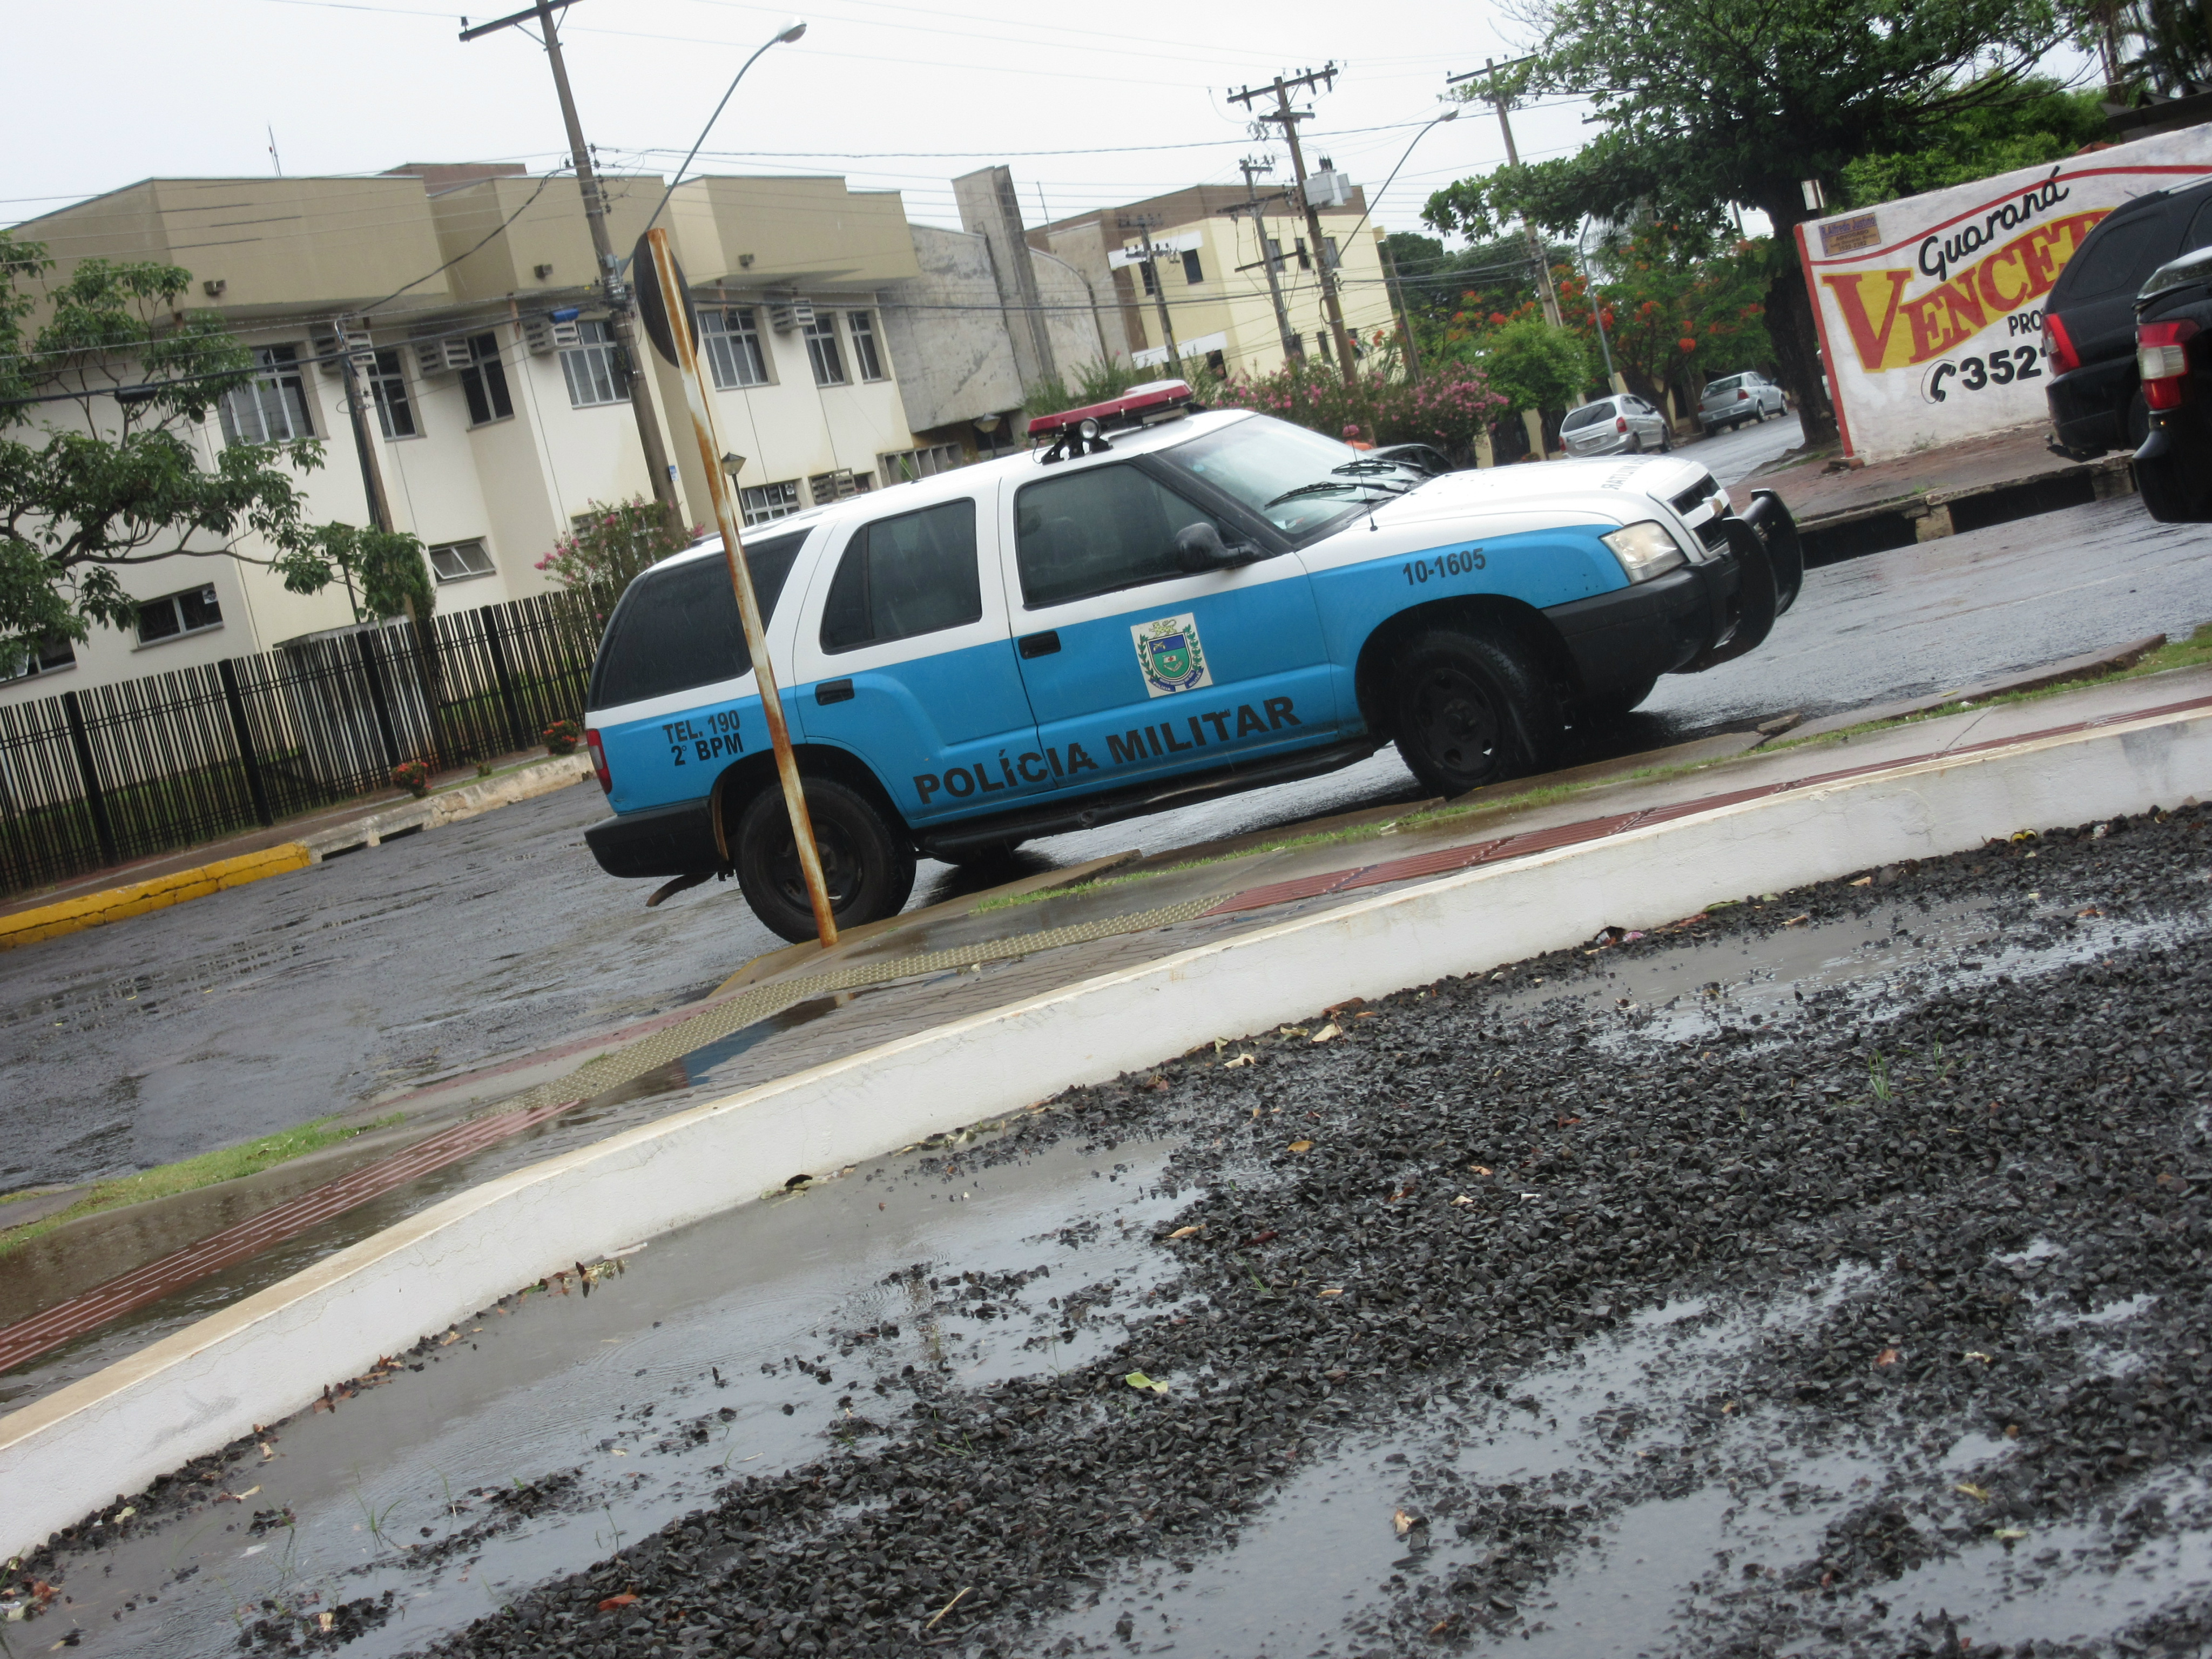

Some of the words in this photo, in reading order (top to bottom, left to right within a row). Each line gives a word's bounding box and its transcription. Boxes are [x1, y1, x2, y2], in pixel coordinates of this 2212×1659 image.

[1836, 229, 1869, 240] ADVOGADO
[1919, 166, 2069, 282] Guaraná
[1959, 345, 2047, 390] 352
[1402, 548, 1486, 585] 10-1605
[662, 720, 704, 744] TEL.
[707, 710, 740, 734] 190
[695, 732, 744, 761] BPM
[913, 743, 1099, 805] POLÍCIA
[1105, 696, 1302, 764] MILITAR
